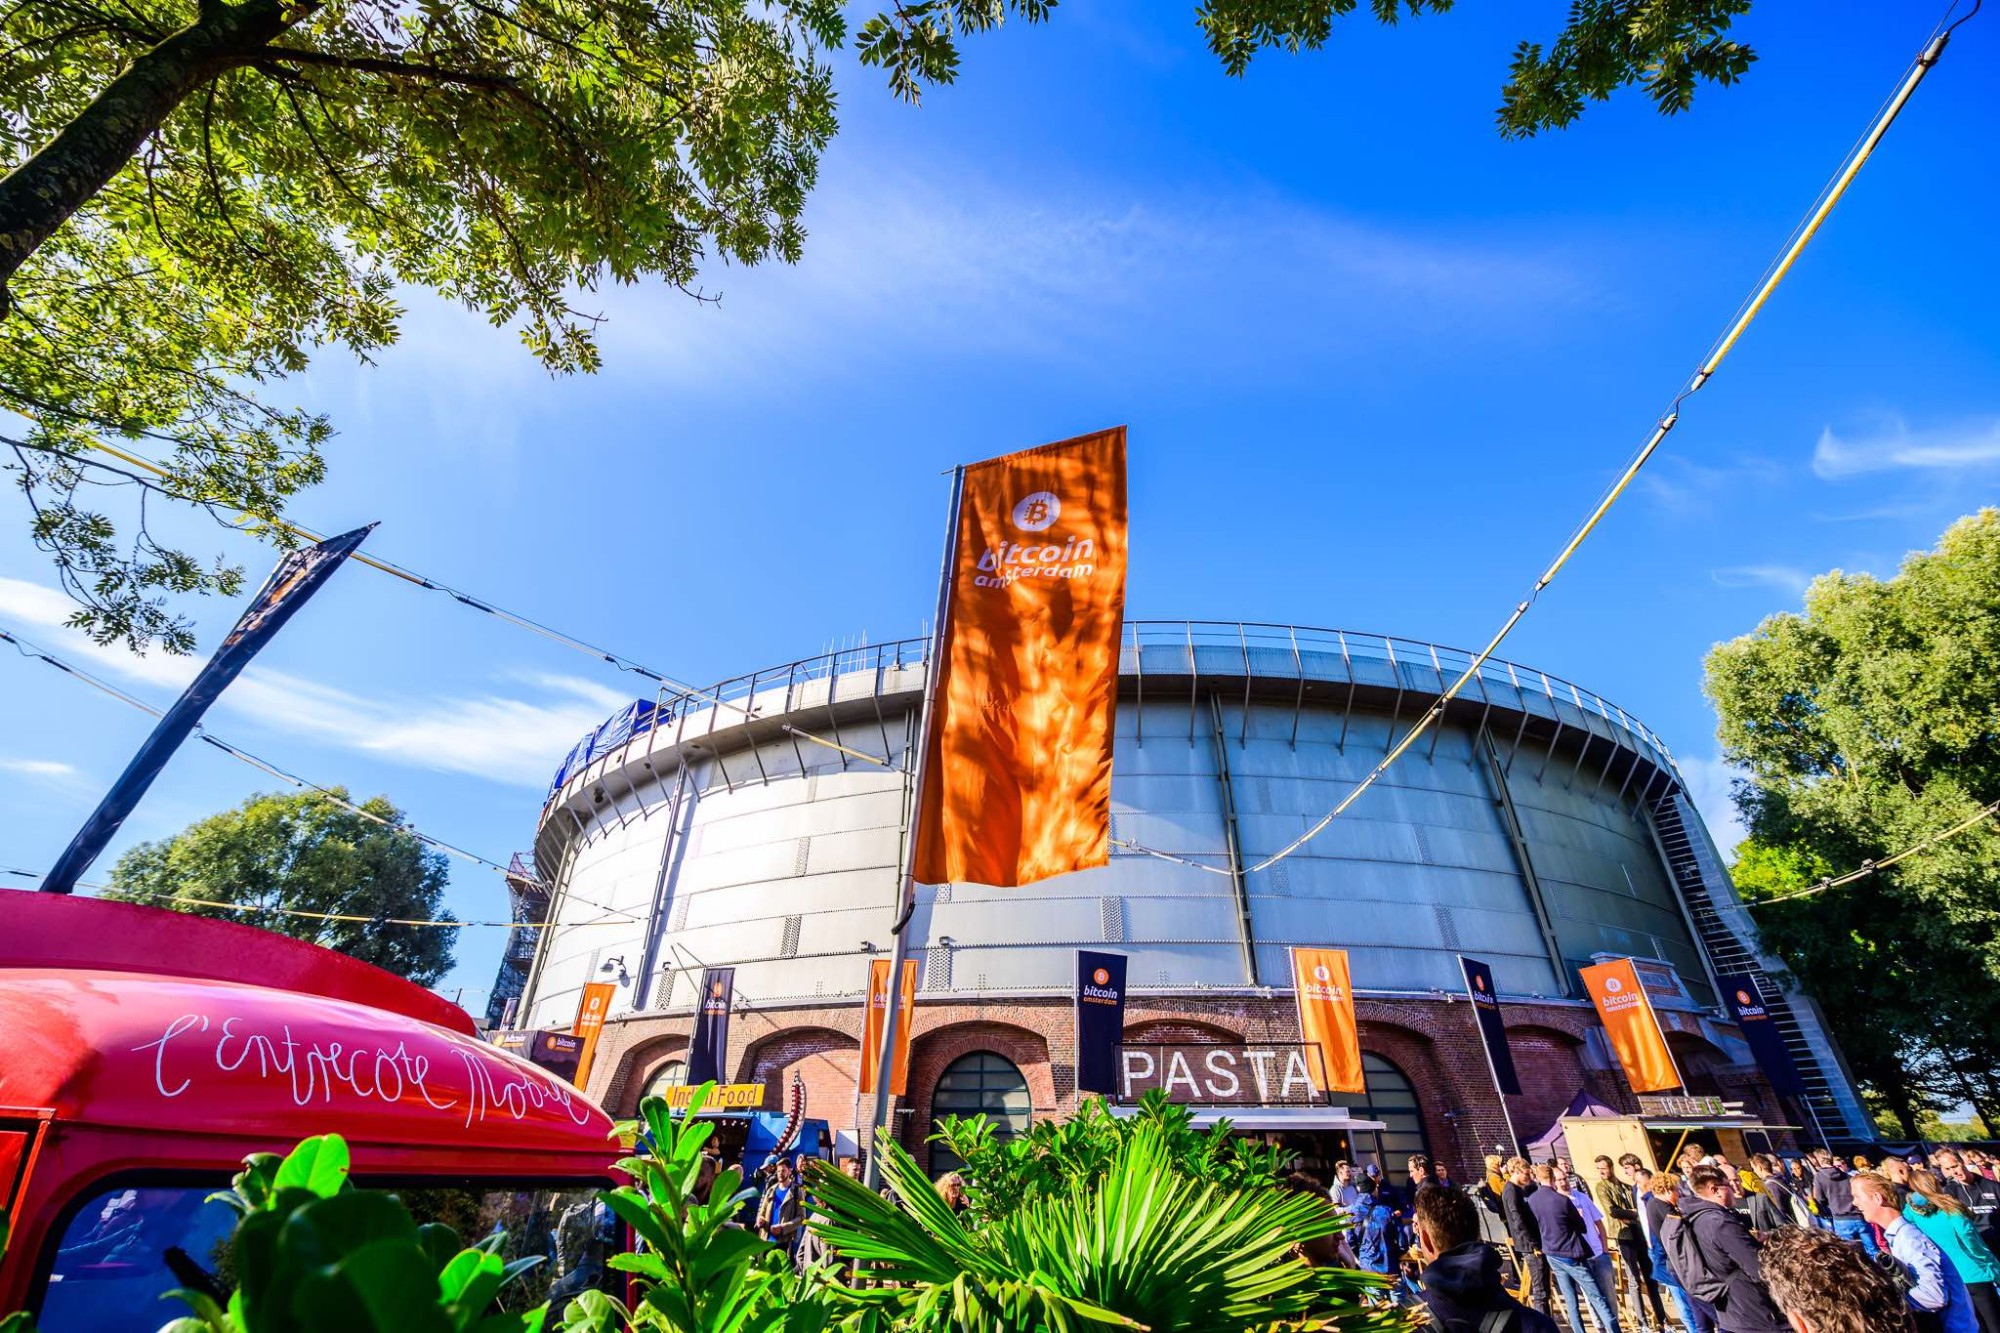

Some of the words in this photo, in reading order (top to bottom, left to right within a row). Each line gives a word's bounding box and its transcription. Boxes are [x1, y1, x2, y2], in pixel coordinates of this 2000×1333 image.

[977, 535, 1094, 572] bitcoin
[974, 563, 1093, 588] amsterdam
[1084, 985, 1118, 999] bitcoin
[1306, 983, 1342, 995] bitcoin
[1602, 992, 1638, 1007] bitcoin
[1737, 1005, 1765, 1016] bitcoin
[1121, 1049, 1321, 1099] PASTA
[716, 1084, 757, 1105] Food
